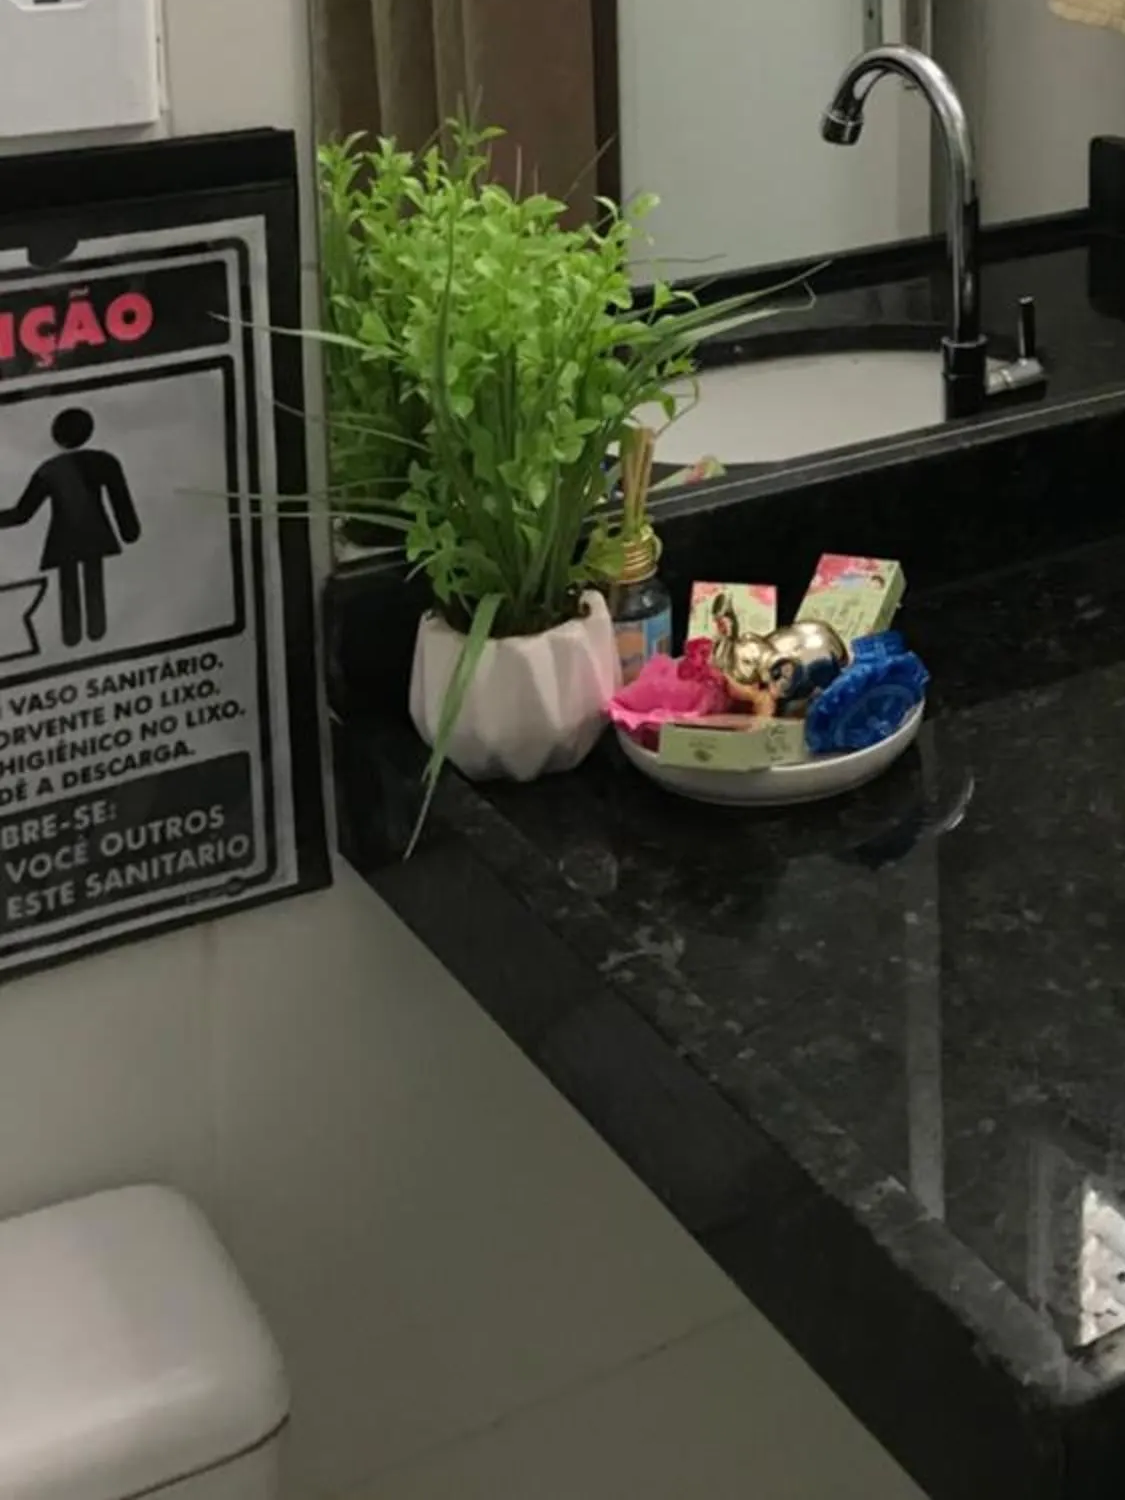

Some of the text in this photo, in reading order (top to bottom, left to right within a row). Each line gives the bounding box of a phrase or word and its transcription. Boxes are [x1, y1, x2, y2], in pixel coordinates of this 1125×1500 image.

[0, 284, 153, 368] ÇÃO
[9, 684, 78, 716] VASO
[114, 695, 153, 721] NO
[161, 679, 220, 708] LIXO.
[141, 716, 178, 741] NO
[186, 700, 246, 729] LIXO.
[36, 777, 54, 796] A
[62, 740, 196, 789] DESCARGA.
[5, 804, 225, 884] VOCÊ OUTROS
[7, 880, 75, 920] ESTE
